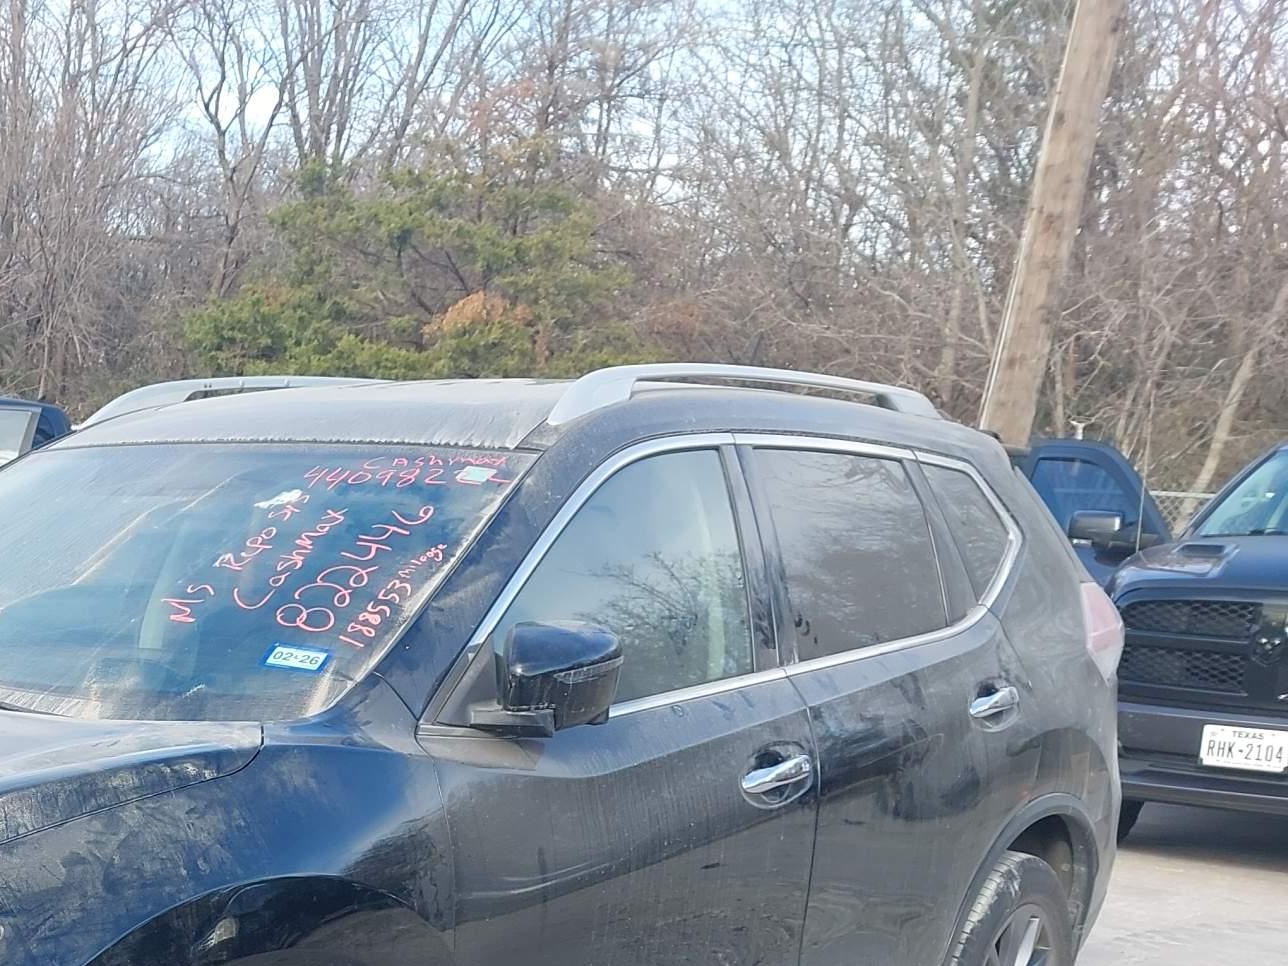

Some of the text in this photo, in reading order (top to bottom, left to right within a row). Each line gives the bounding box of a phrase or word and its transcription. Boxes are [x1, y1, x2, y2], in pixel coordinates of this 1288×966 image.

[303, 466, 512, 490] 4409822
[338, 579, 412, 648] 188553
[1231, 730, 1265, 740] TEXAS
